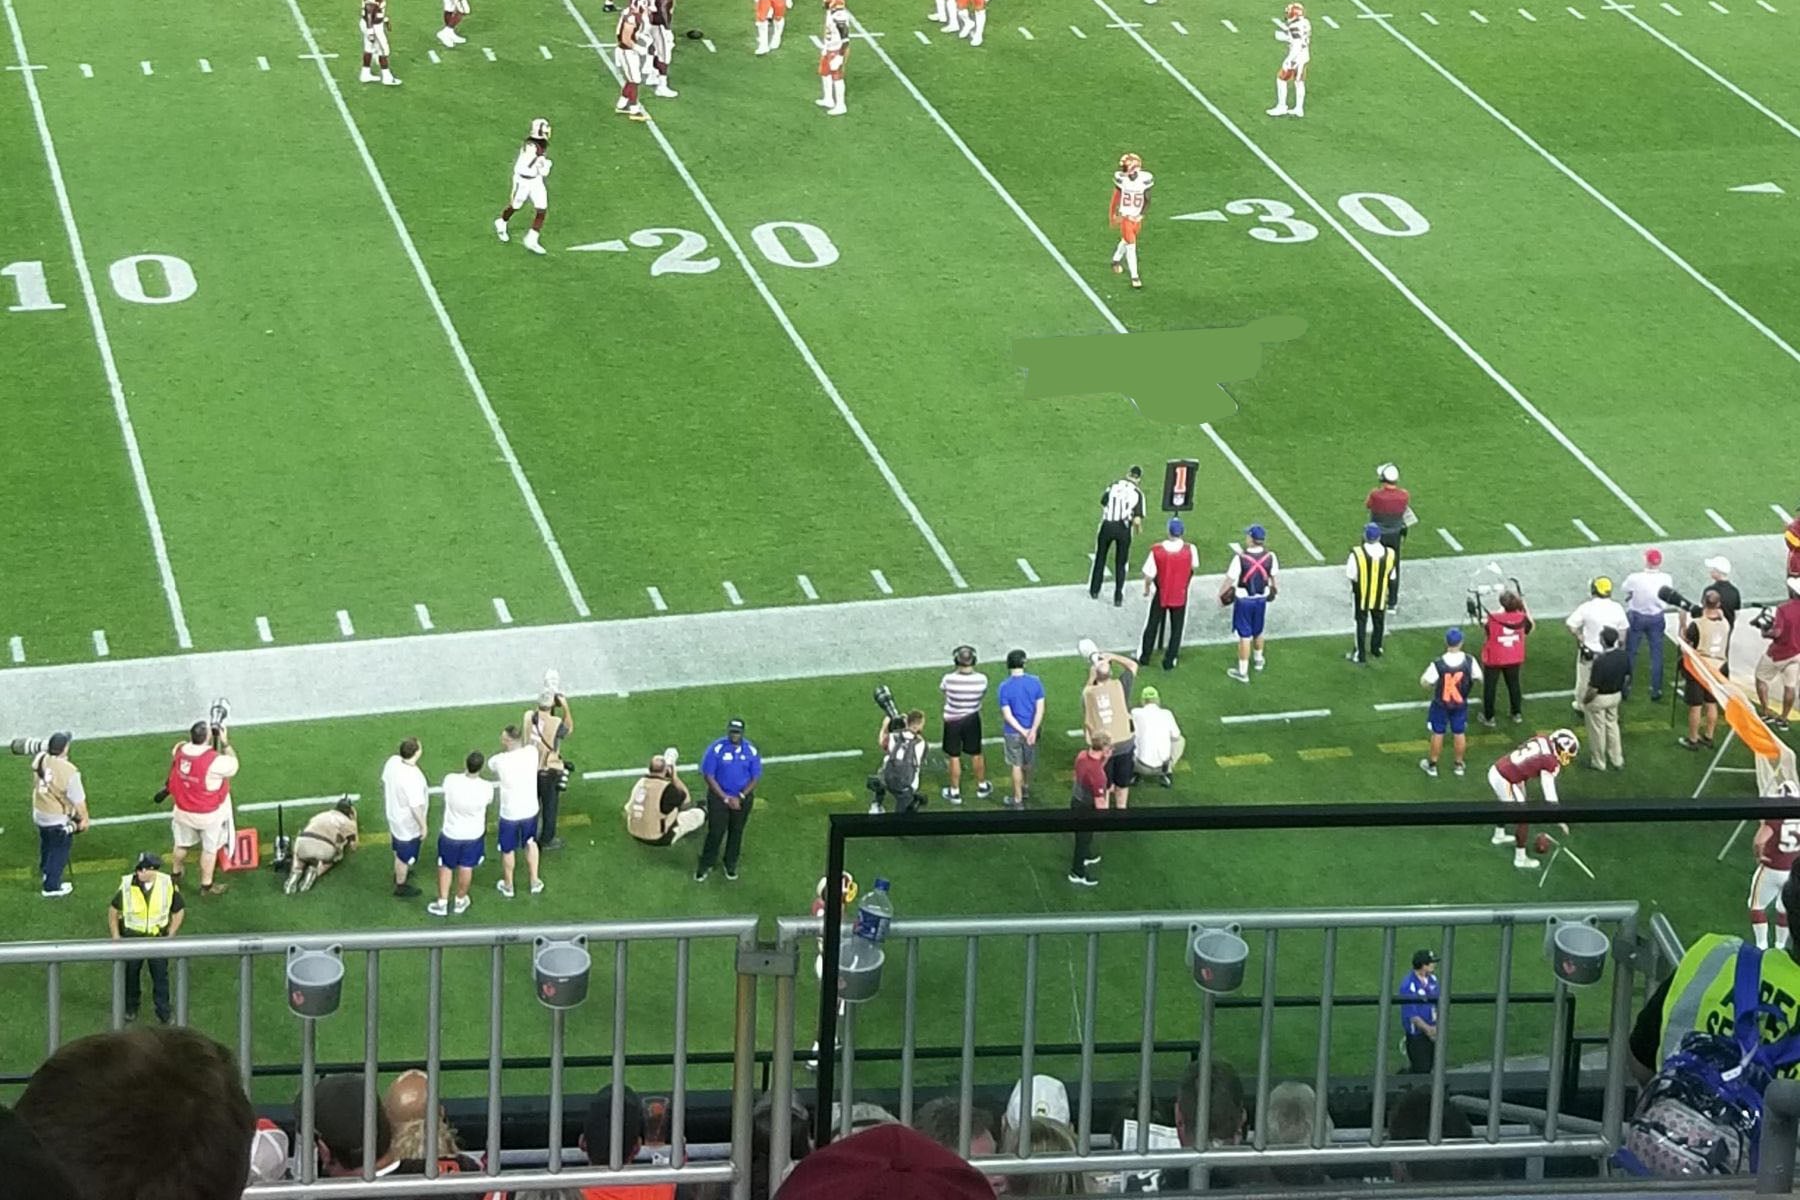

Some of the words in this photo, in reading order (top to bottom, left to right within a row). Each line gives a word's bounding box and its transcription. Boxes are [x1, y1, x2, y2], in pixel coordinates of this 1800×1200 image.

[1122, 192, 1144, 208] 26
[1225, 192, 1430, 243] 30
[629, 221, 840, 276] 20
[0, 254, 198, 311] 10
[1174, 466, 1187, 493] 1
[1442, 671, 1464, 704] K
